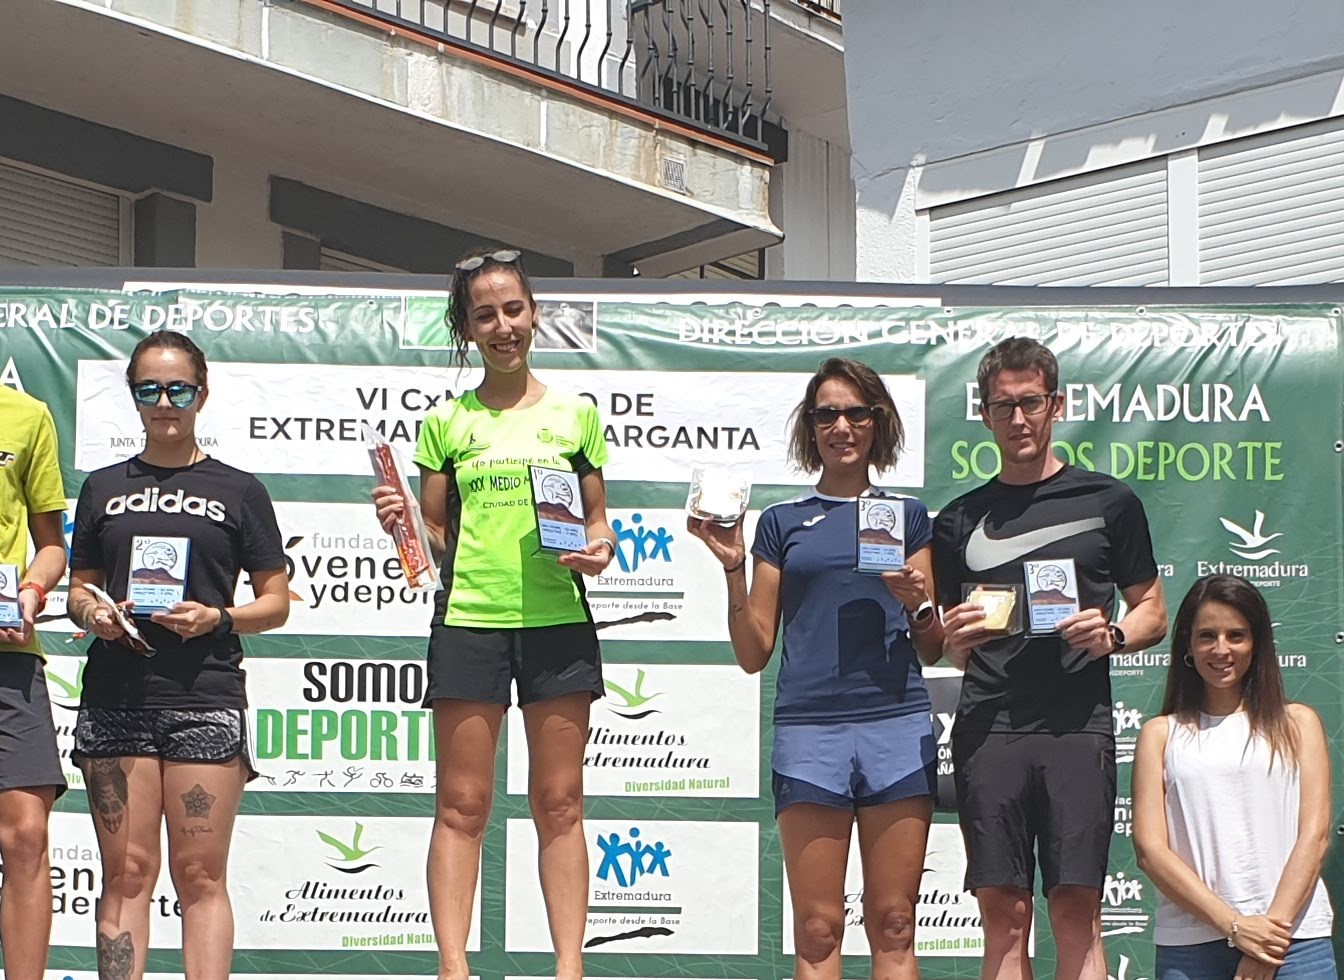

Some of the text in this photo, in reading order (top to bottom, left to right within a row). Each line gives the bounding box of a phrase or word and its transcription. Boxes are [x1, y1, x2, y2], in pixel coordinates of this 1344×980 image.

[88, 304, 131, 330] DE
[143, 302, 316, 333] DEPORTES
[356, 387, 388, 411] VI
[611, 393, 655, 417] DE
[603, 425, 761, 451] ARGANTA
[1110, 441, 1285, 481] DEPORTE
[106, 487, 227, 522] adidas
[1197, 560, 1308, 578] Extremadura
[597, 575, 674, 587] Extremadura
[303, 661, 423, 704] SOMO
[624, 776, 730, 793] Diversidad Natural
[285, 881, 407, 901] Alimentos
[594, 890, 672, 902] Extremadura
[259, 903, 430, 924] de Extremadura
[342, 933, 404, 948] Diversidad
